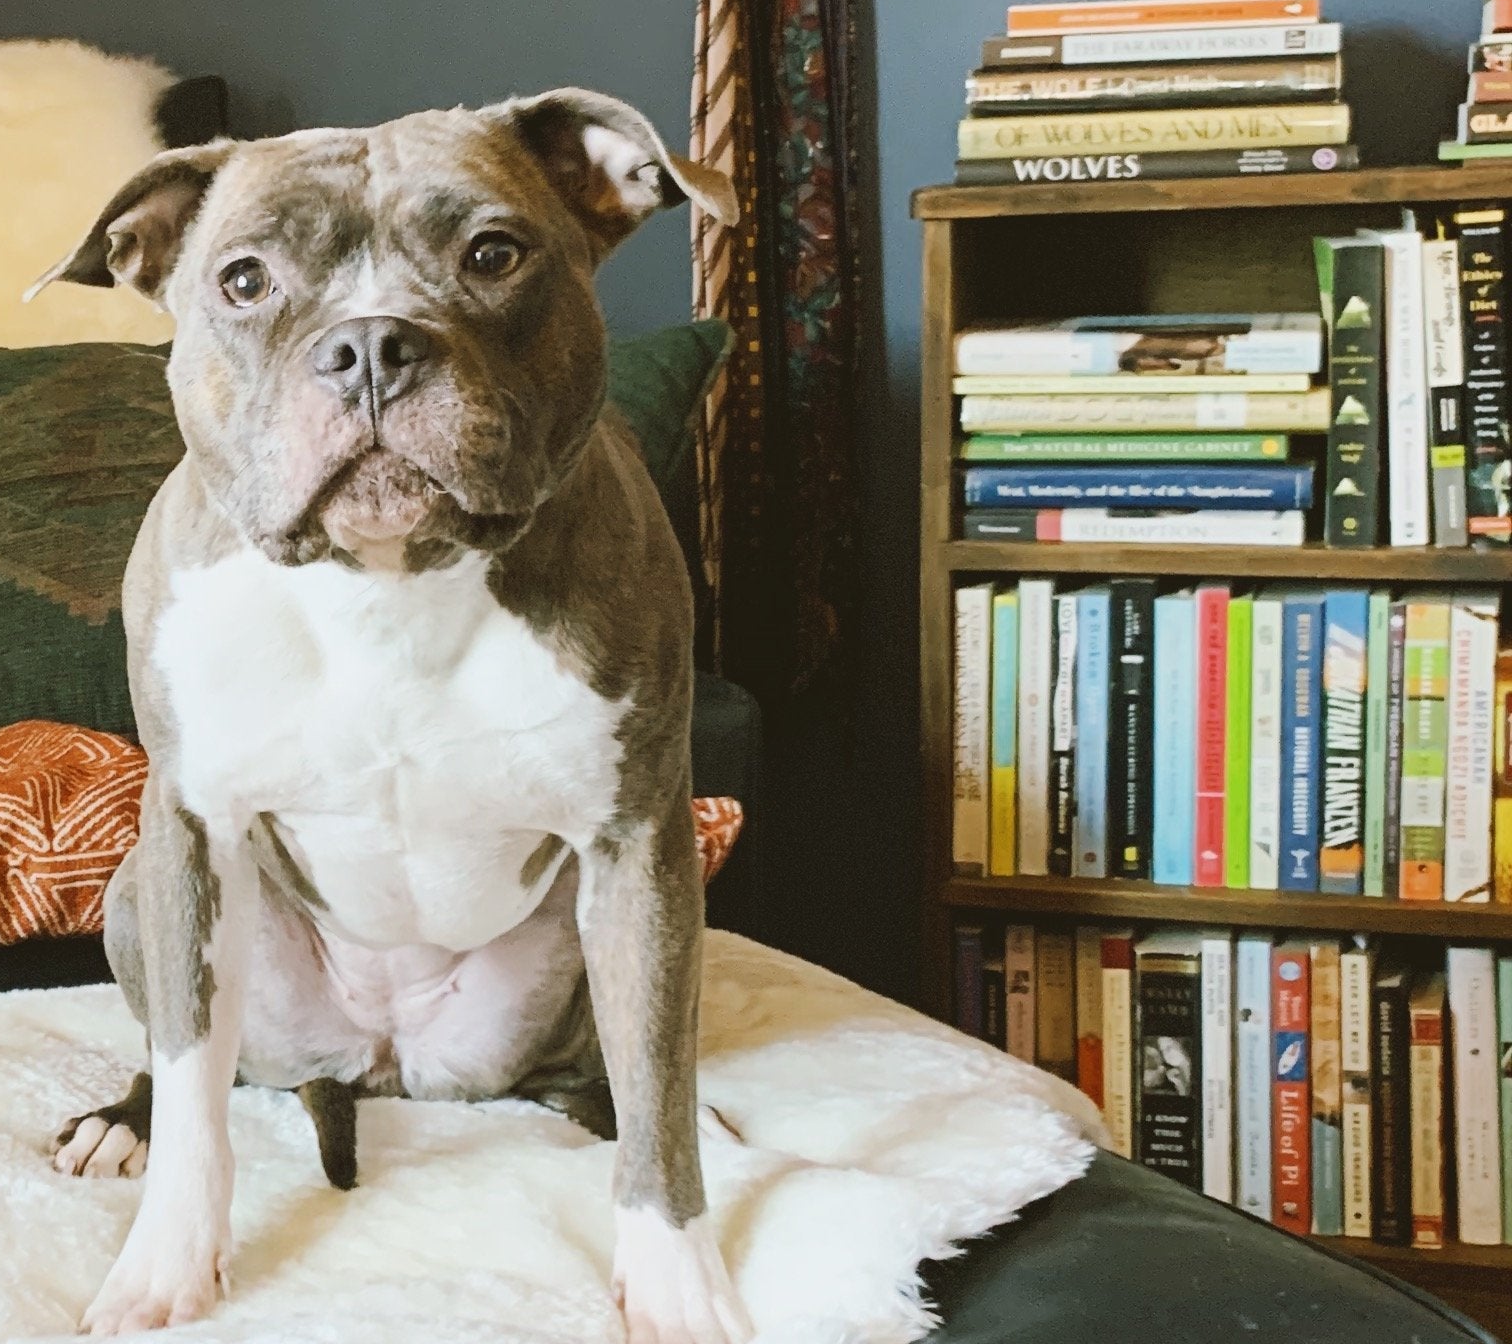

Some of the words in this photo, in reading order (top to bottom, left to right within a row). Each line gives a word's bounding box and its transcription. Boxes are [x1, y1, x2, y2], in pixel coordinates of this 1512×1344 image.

[996, 126, 1026, 148] OF
[1045, 122, 1153, 145] WOLVES
[1165, 119, 1224, 141] AND
[1230, 115, 1293, 137] MEN
[1012, 154, 1141, 182] WOLVES
[1032, 442, 1102, 453] NATURAL
[1106, 441, 1179, 453] MEDICINE
[1184, 441, 1251, 453] CABINET
[1061, 602, 1073, 634] LOVE
[1454, 630, 1472, 727] CHIMAMANDA
[1294, 726, 1312, 775] NATIONAL
[1472, 690, 1488, 784] AMERICANAH
[1451, 736, 1470, 778] NGOZI
[1292, 777, 1310, 836] INSECURITY
[1322, 756, 1362, 849] FRANZEN
[1450, 785, 1468, 840] ADICHIE
[1349, 963, 1360, 999] NEVER
[1350, 1004, 1360, 1025] LET
[1280, 1091, 1299, 1132] Life
[1280, 1136, 1299, 1157] of
[1281, 1165, 1299, 1185] Pi
